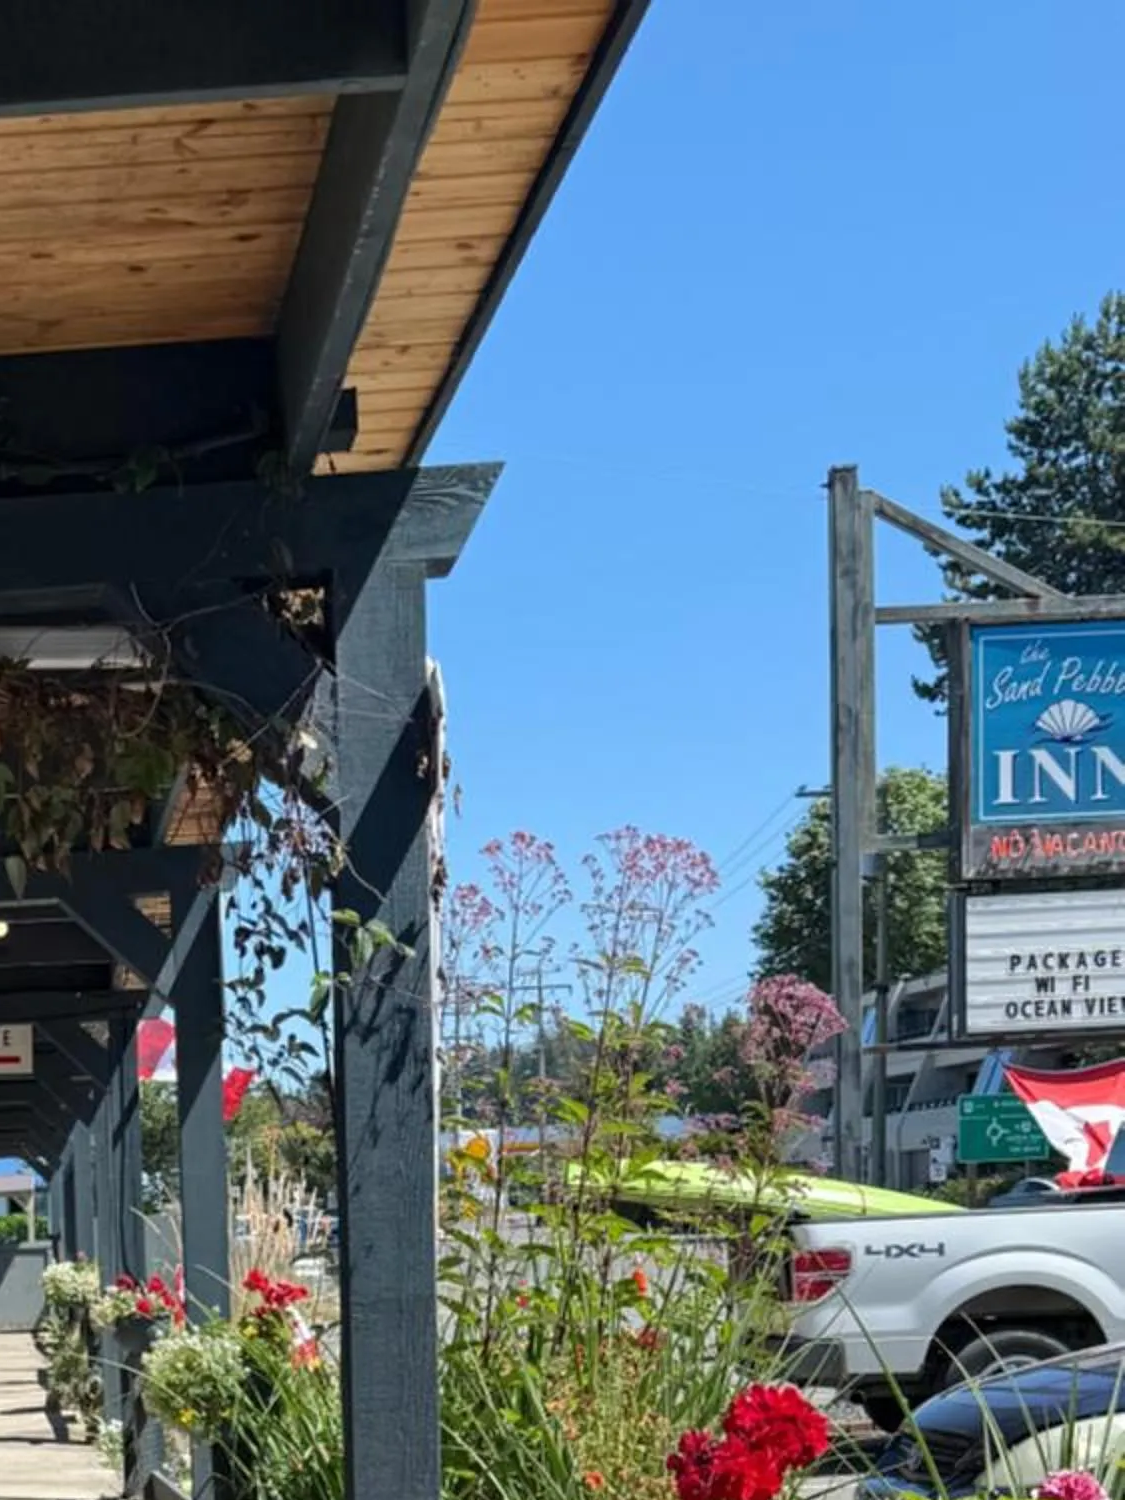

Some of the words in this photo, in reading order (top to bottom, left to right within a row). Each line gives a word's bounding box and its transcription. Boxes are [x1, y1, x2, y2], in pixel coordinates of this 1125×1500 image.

[1020, 640, 1049, 664] the
[986, 662, 1050, 709] Sand
[990, 829, 1025, 862] NO
[1010, 950, 1121, 971] PACKAGE
[1035, 976, 1055, 993] WI
[1072, 975, 1090, 992] FI
[1005, 999, 1072, 1019] OCEAN
